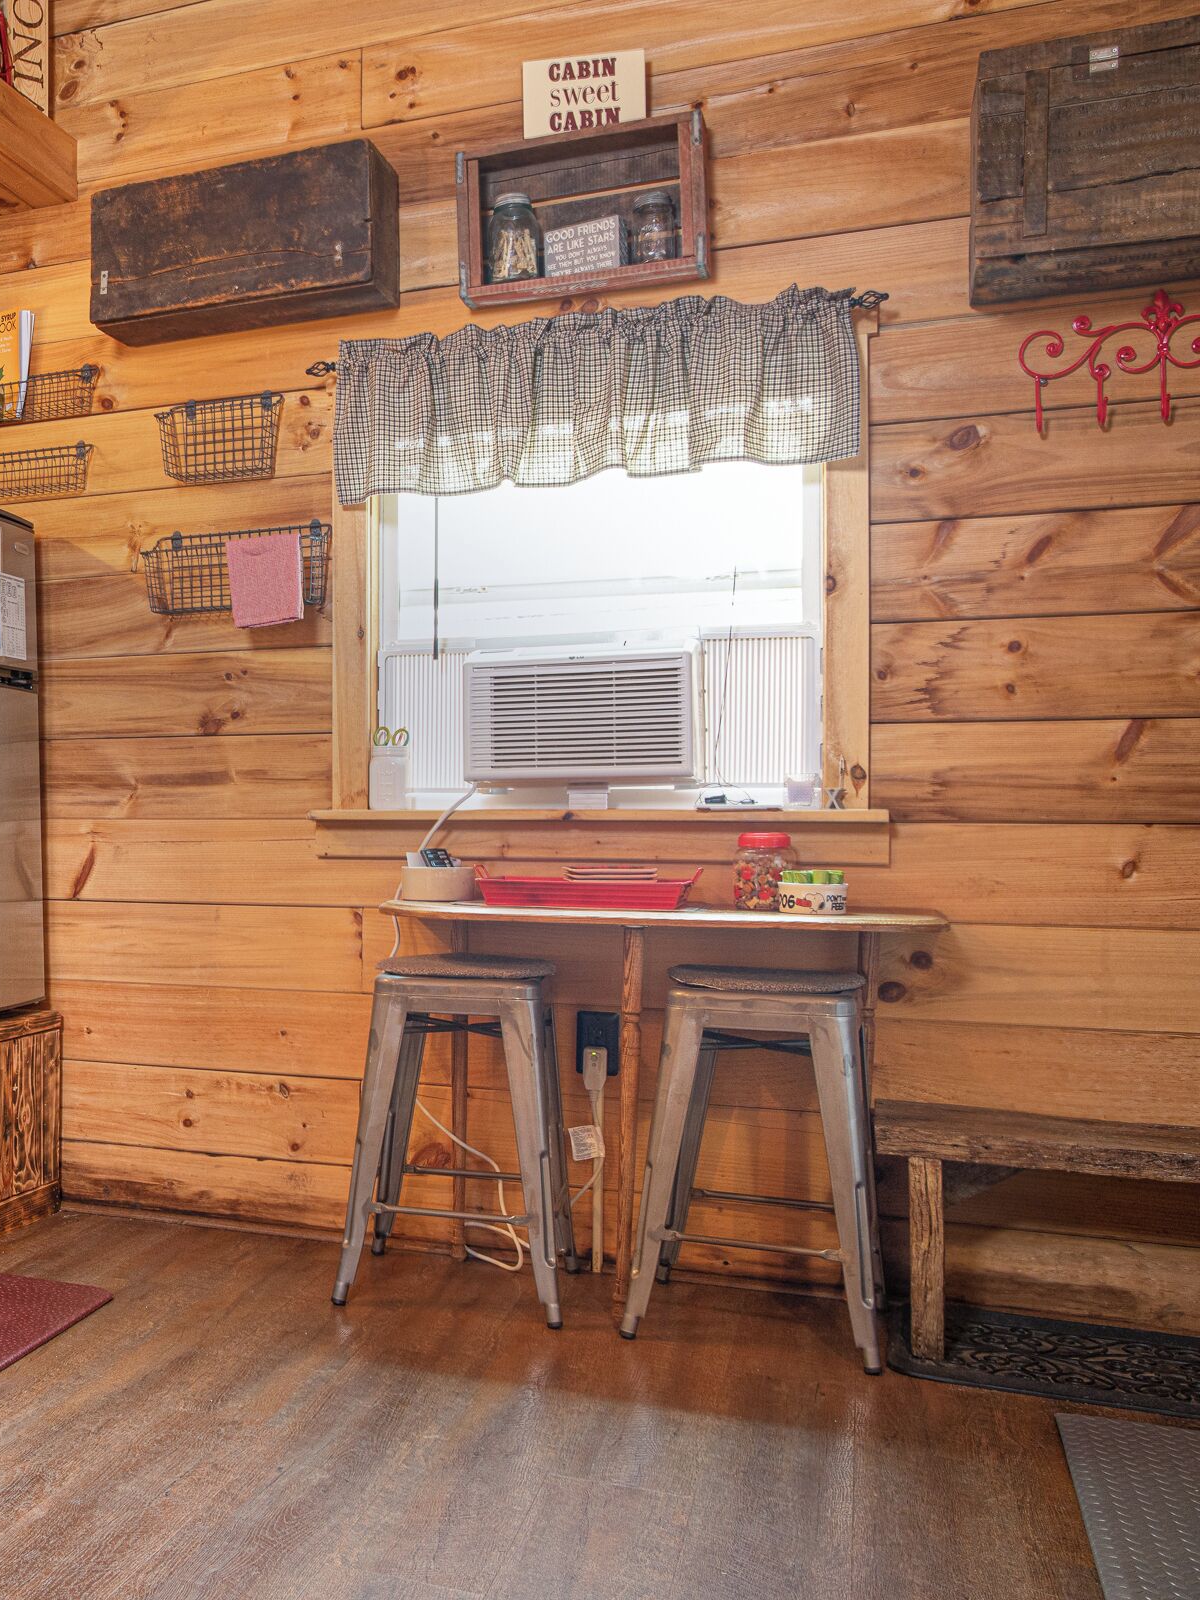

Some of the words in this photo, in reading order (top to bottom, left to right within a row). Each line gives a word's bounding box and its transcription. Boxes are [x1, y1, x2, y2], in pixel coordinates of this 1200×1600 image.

[548, 58, 617, 82] CABIN
[550, 80, 621, 107] sweet
[549, 107, 621, 132] CABIN
[546, 228, 575, 243] GOOD
[577, 218, 616, 237] FRIENDS
[547, 242, 565, 256] ARE
[566, 237, 585, 251] LIKE
[587, 231, 615, 246] STARS
[568, 250, 585, 259] DON'T
[587, 245, 608, 254] ALWAYS
[547, 263, 557, 271] SEE
[558, 260, 573, 268] THEM
[573, 257, 584, 266] BUT
[599, 251, 616, 259] KNOW
[574, 264, 595, 273] ALWAYS
[1, 312, 16, 322] SYRUP
